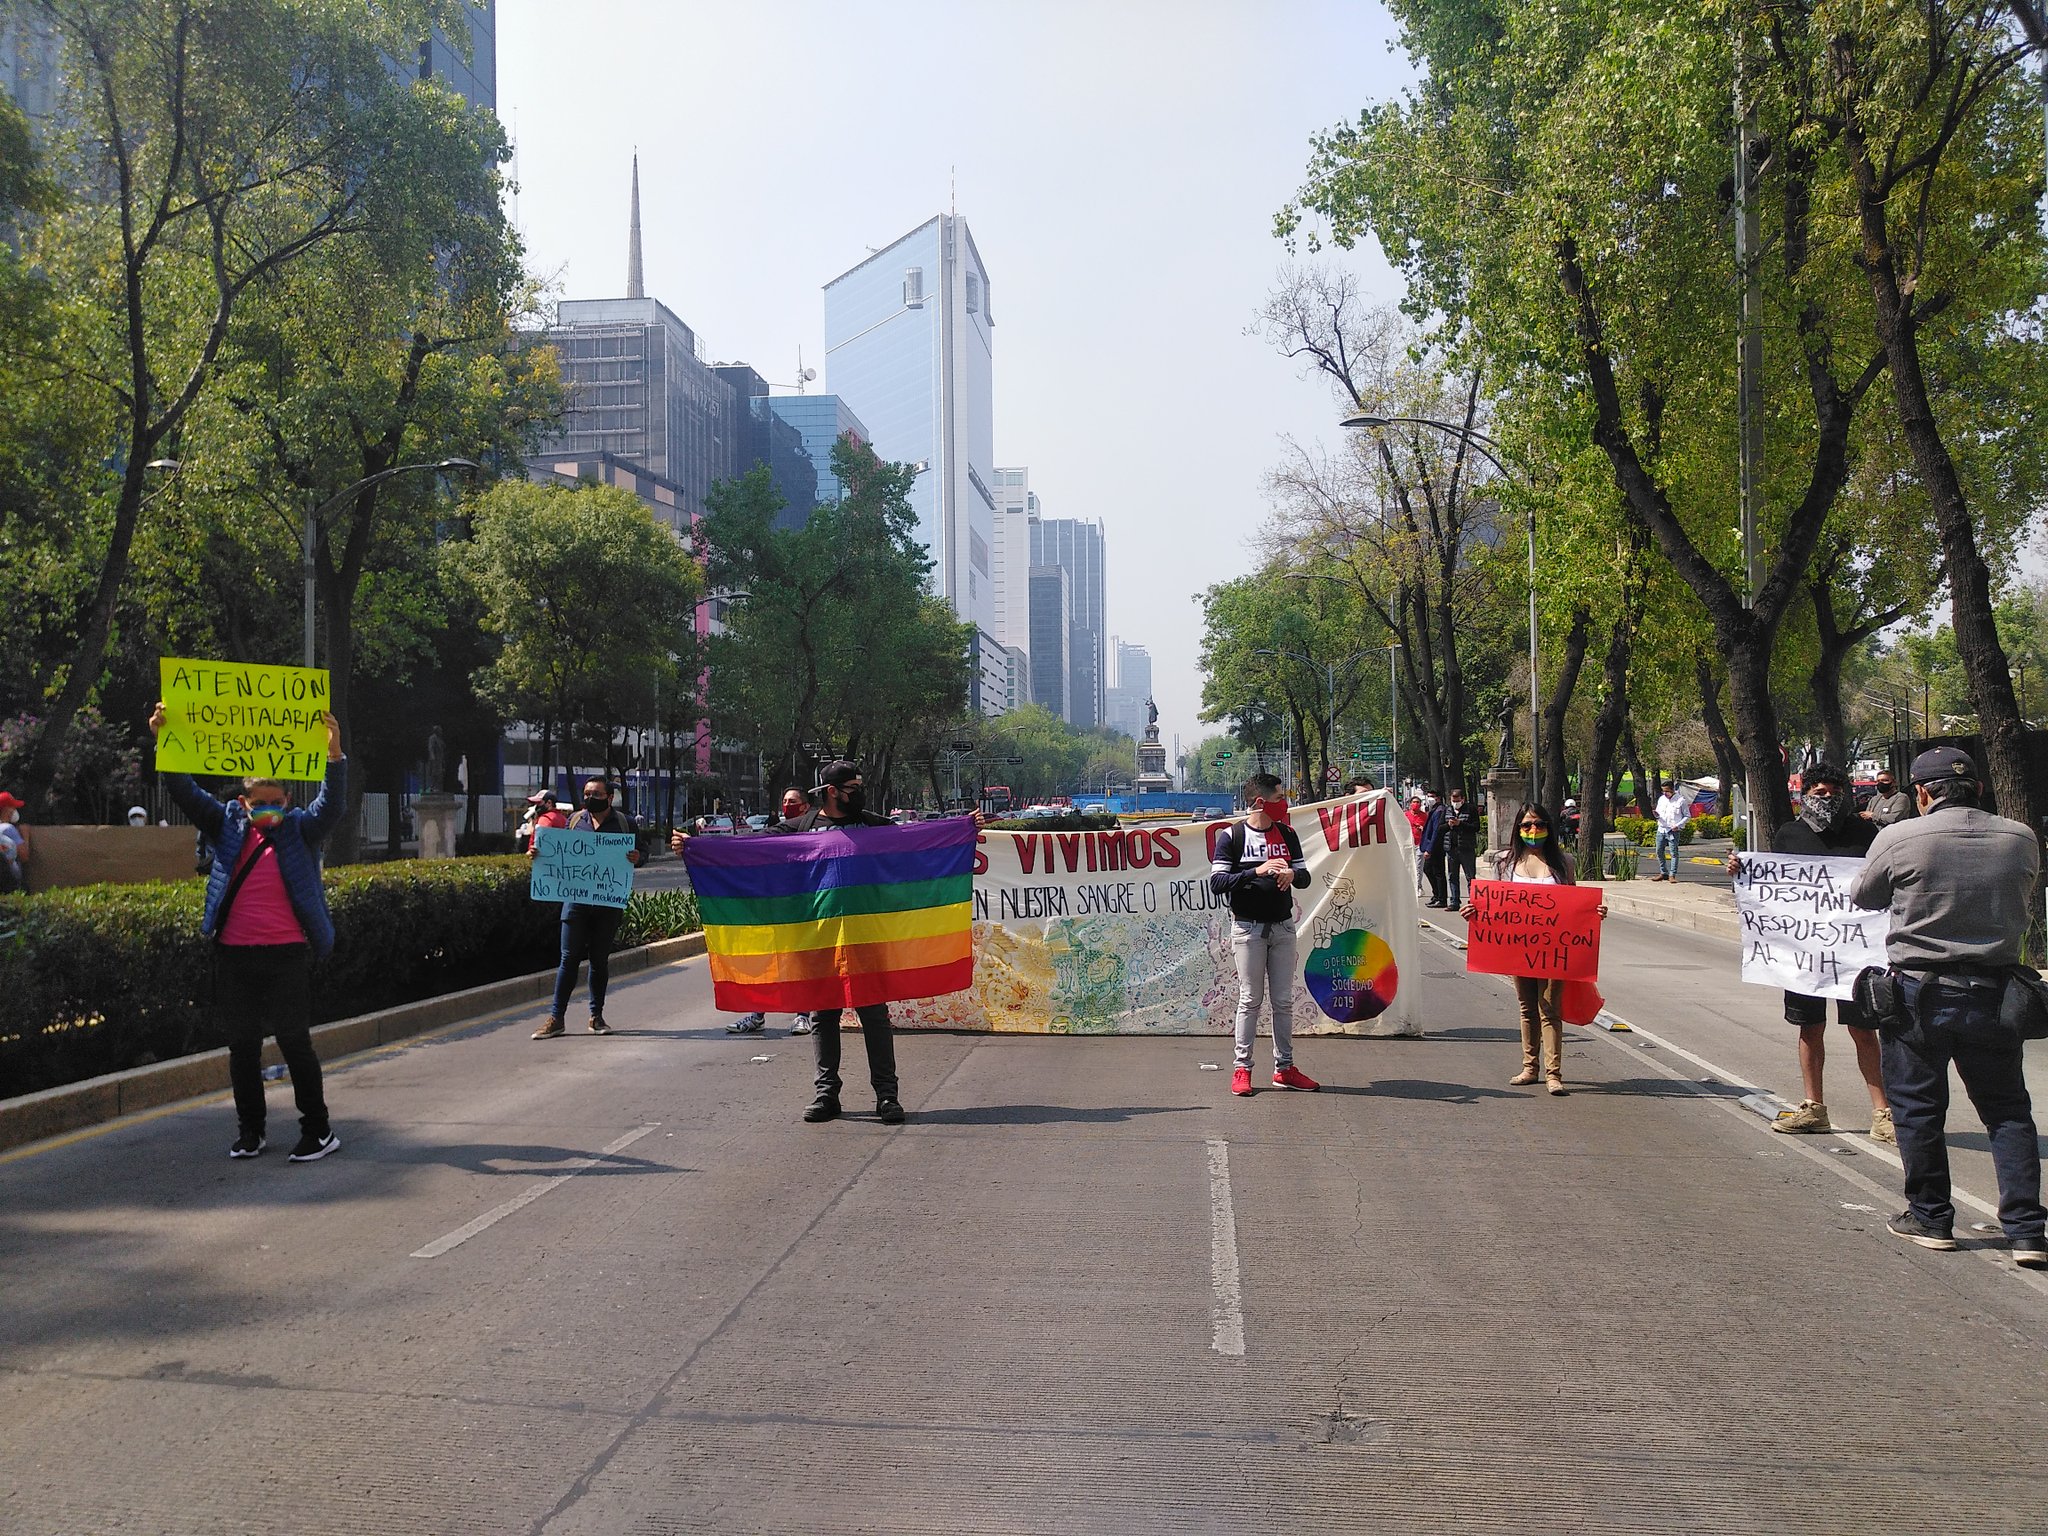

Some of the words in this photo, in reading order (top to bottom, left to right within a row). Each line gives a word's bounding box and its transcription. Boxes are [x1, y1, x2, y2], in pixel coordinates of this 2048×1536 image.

[173, 667, 326, 701] ATENCIÓN
[186, 702, 326, 732] HOSPITALARIA
[163, 731, 186, 752] A
[193, 730, 295, 754] PERSONAS
[204, 754, 255, 772] CON
[269, 752, 320, 776] VIH
[1317, 797, 1388, 852] VIH
[1011, 827, 1181, 875] VIVIMOS
[1243, 844, 1291, 858] ILFIGE
[1000, 885, 1070, 920] NUESTRA
[1077, 882, 1138, 915] SANGRE
[1143, 882, 1156, 913] O
[1474, 885, 1557, 910] MUJERES
[1474, 909, 1560, 927] TAMBIEN
[1742, 909, 1868, 949] RESPUESTA
[1474, 929, 1551, 948] VIVIMOS
[1559, 929, 1594, 947] CON
[1524, 946, 1568, 972] VIH
[1743, 940, 1778, 967] AL
[1794, 950, 1842, 985] VIH
[1331, 968, 1342, 978] LA
[1331, 978, 1375, 991] SOCIEDAD
[1332, 995, 1355, 1009] 2019
